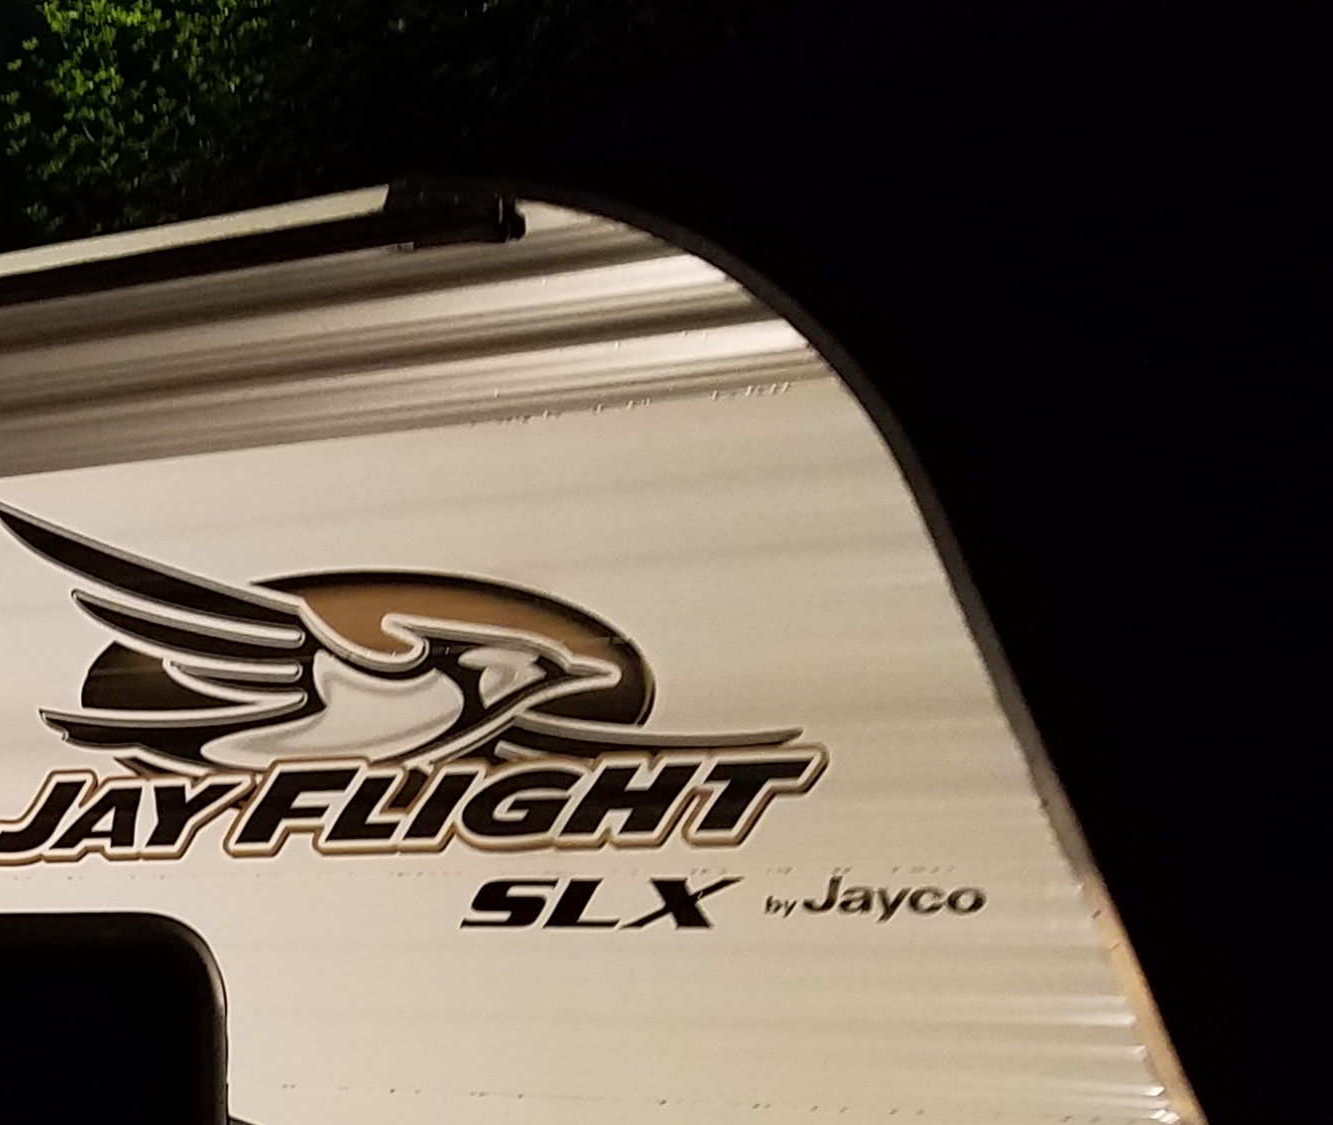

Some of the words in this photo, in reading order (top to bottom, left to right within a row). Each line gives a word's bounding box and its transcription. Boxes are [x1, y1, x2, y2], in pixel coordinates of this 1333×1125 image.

[225, 748, 828, 856] FLIGHT
[460, 877, 744, 930] SLX
[765, 895, 797, 918] by
[803, 876, 986, 923] Jayco
